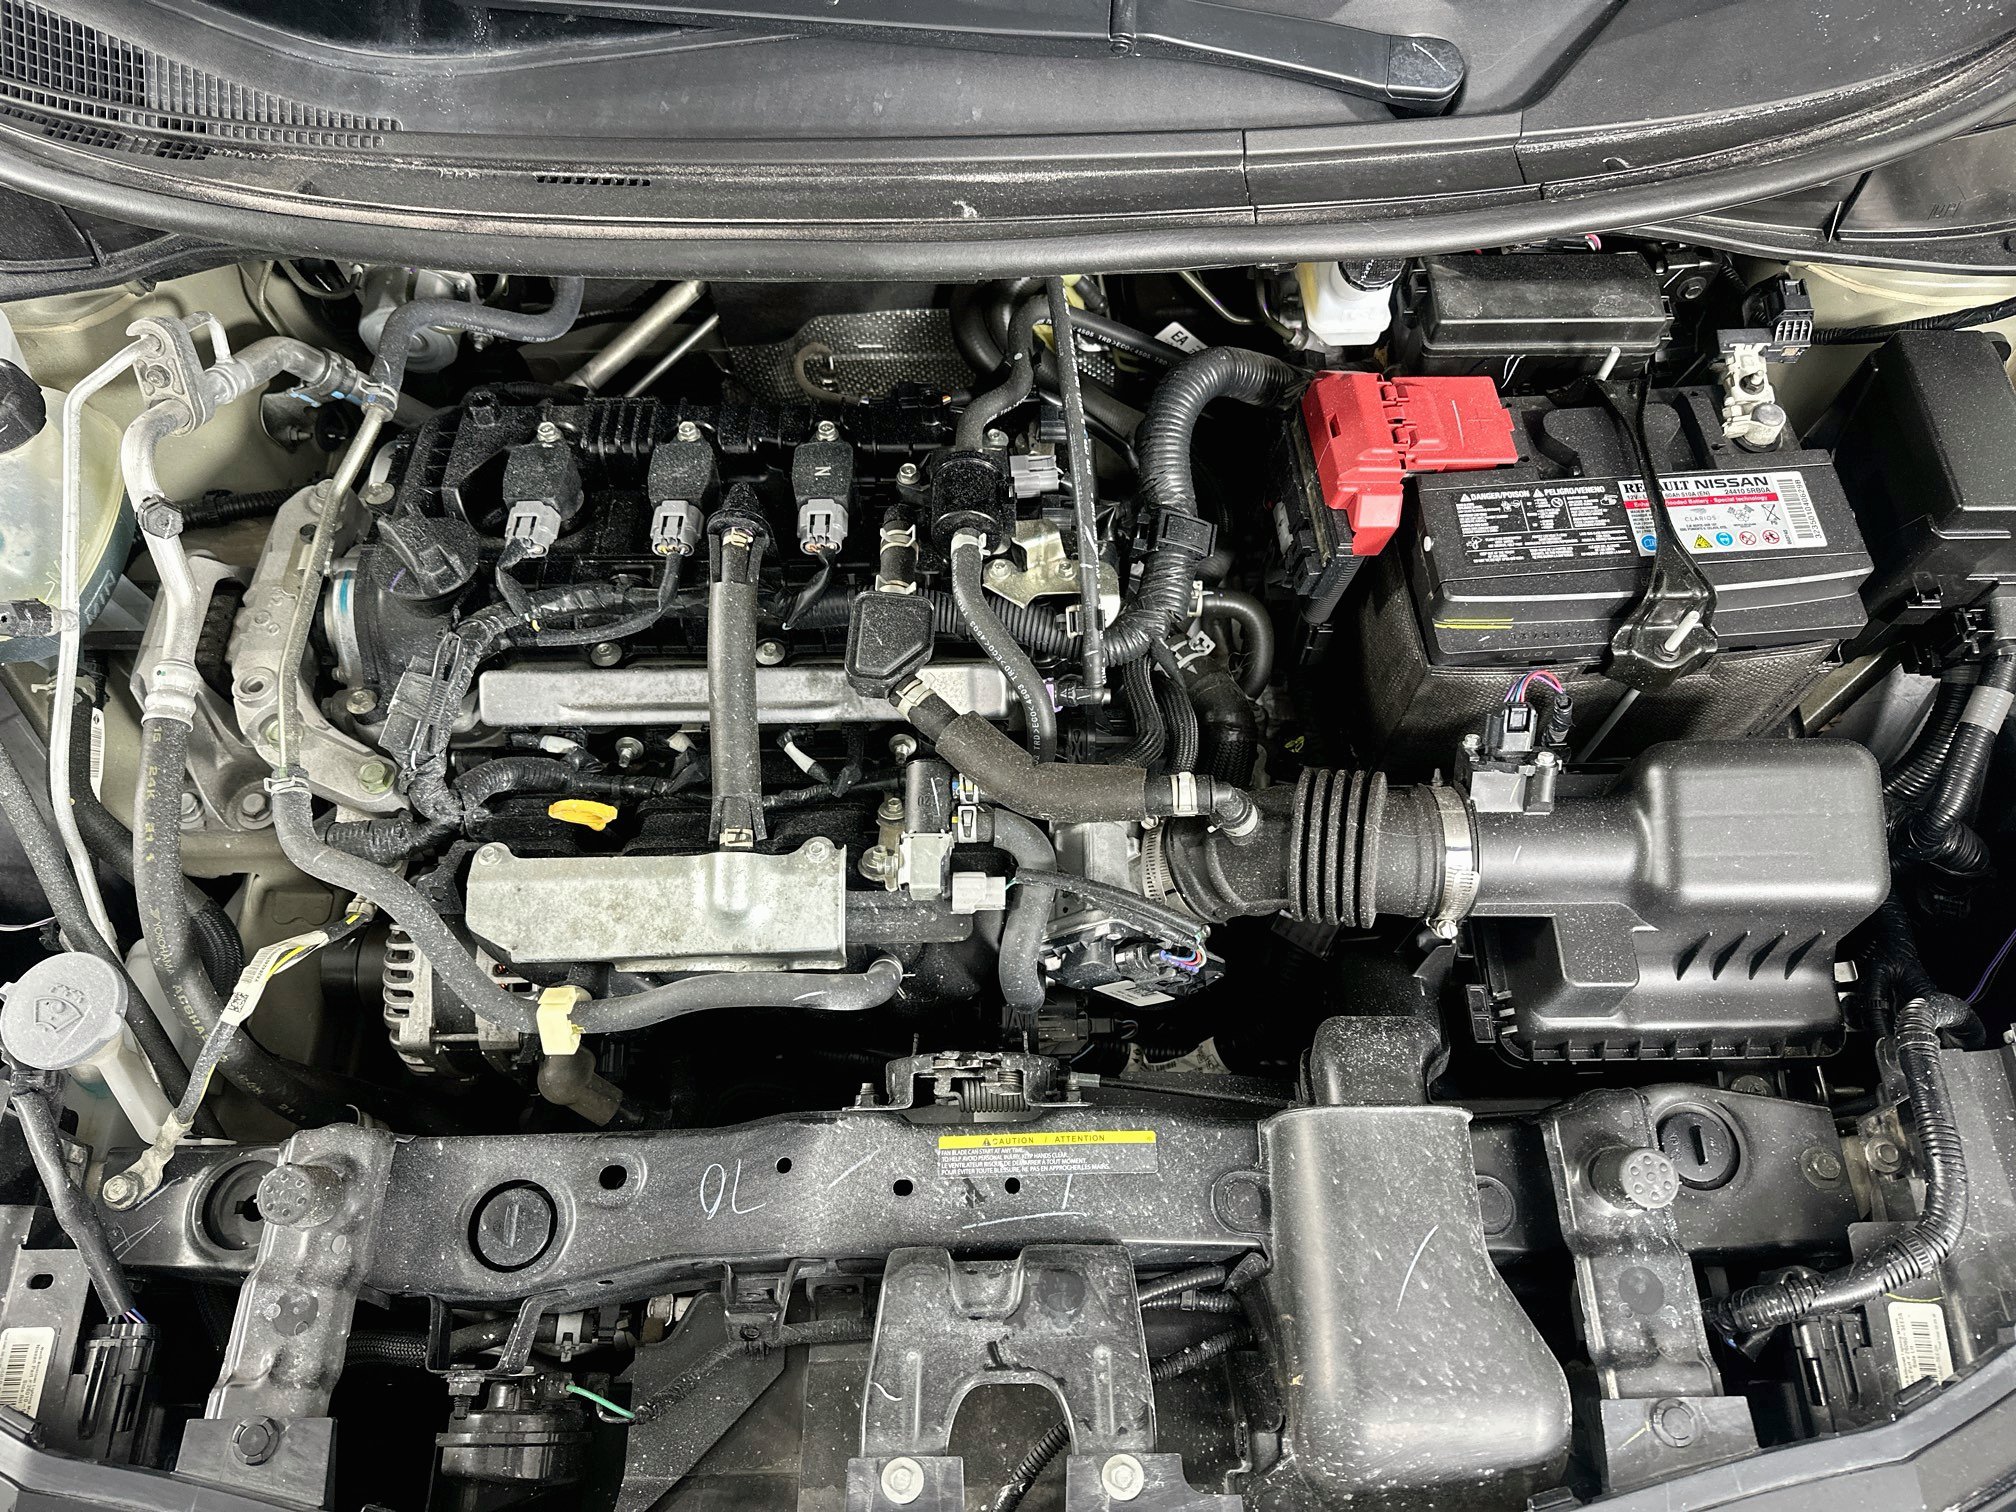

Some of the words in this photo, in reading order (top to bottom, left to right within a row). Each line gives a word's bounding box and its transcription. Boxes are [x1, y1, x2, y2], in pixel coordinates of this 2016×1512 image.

[1171, 331, 1188, 345] EA
[1544, 485, 1605, 496] PELIGRO/VENENO
[1694, 476, 1769, 491] NISSAN
[1470, 490, 1530, 501] DANGER/POISON
[84, 569, 117, 626] MIN
[153, 920, 176, 976] YOKOHAMA
[992, 1136, 1034, 1145] CAUTION
[1054, 1134, 1105, 1143] ATTENTION
